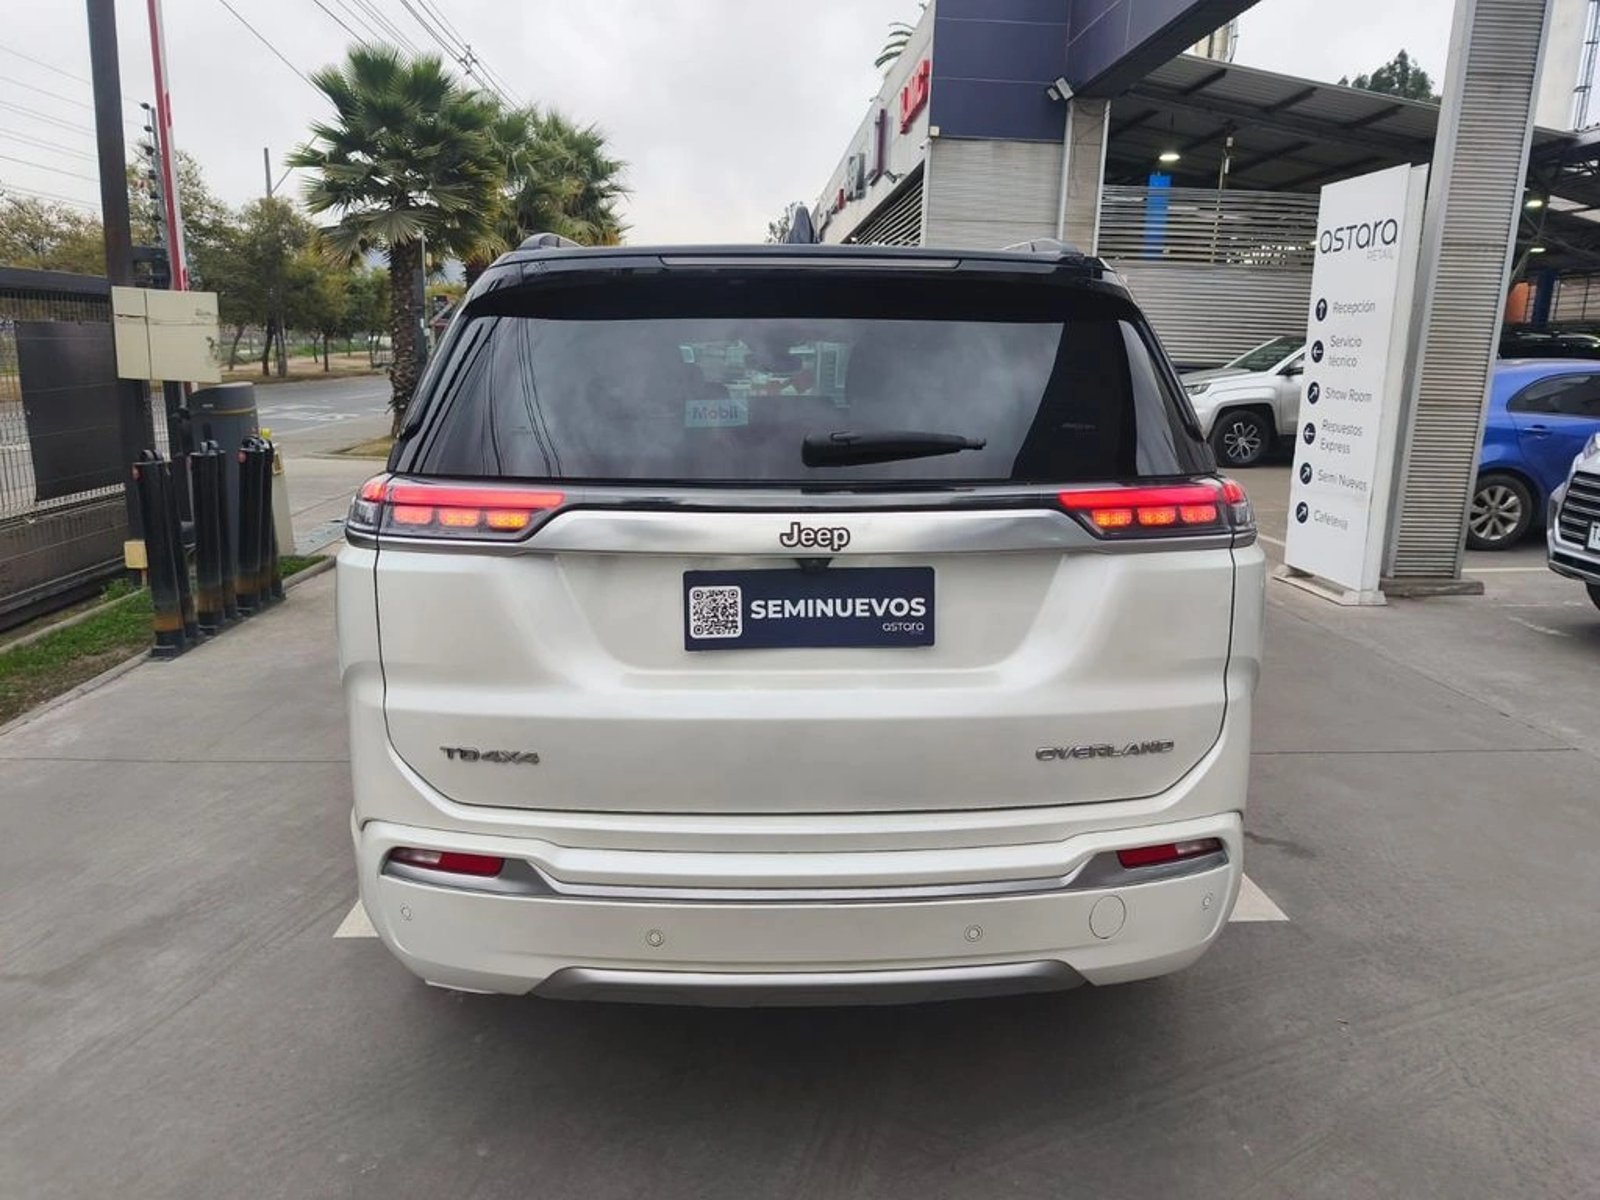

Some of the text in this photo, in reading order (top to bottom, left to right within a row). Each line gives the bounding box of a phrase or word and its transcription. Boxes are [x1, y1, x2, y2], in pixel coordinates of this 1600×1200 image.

[1320, 218, 1398, 254] astara
[1332, 300, 1376, 315] Recepción
[1329, 335, 1362, 348] Servicio
[1324, 386, 1373, 402] Show Room
[1321, 419, 1363, 436] Repuestos
[1320, 437, 1351, 454] Express
[780, 522, 850, 551] Jeep
[750, 597, 926, 619] SEMINUEVOS
[882, 621, 925, 632] astara
[1036, 739, 1174, 761] OVERLAND
